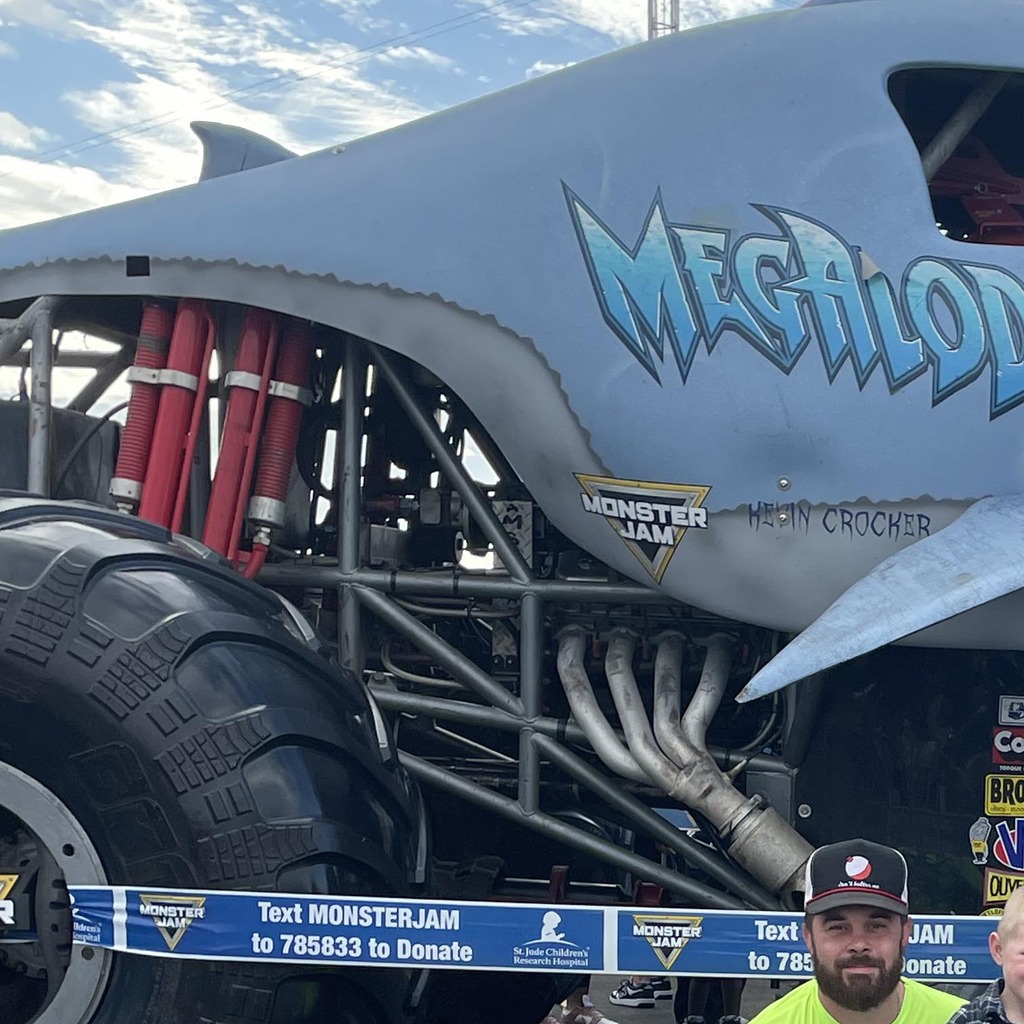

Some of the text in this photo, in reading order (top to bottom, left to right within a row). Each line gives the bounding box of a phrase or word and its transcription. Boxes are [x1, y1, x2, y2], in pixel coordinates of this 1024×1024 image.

[581, 493, 708, 529] MONSTER
[618, 523, 675, 546] JAM
[822, 507, 932, 543] CROCKER
[139, 904, 206, 919] MONSTER
[156, 917, 187, 928] JAM
[257, 901, 460, 930] Text MONSTERJAM
[633, 925, 702, 938] MONSTER
[652, 937, 683, 948] JAM
[754, 920, 954, 945] Text JAM
[251, 933, 473, 962] to 785833 to Donate
[513, 947, 588, 957] St. Jude Children's
[513, 956, 589, 967] Research Hospital
[748, 951, 967, 975] to 785 onate
